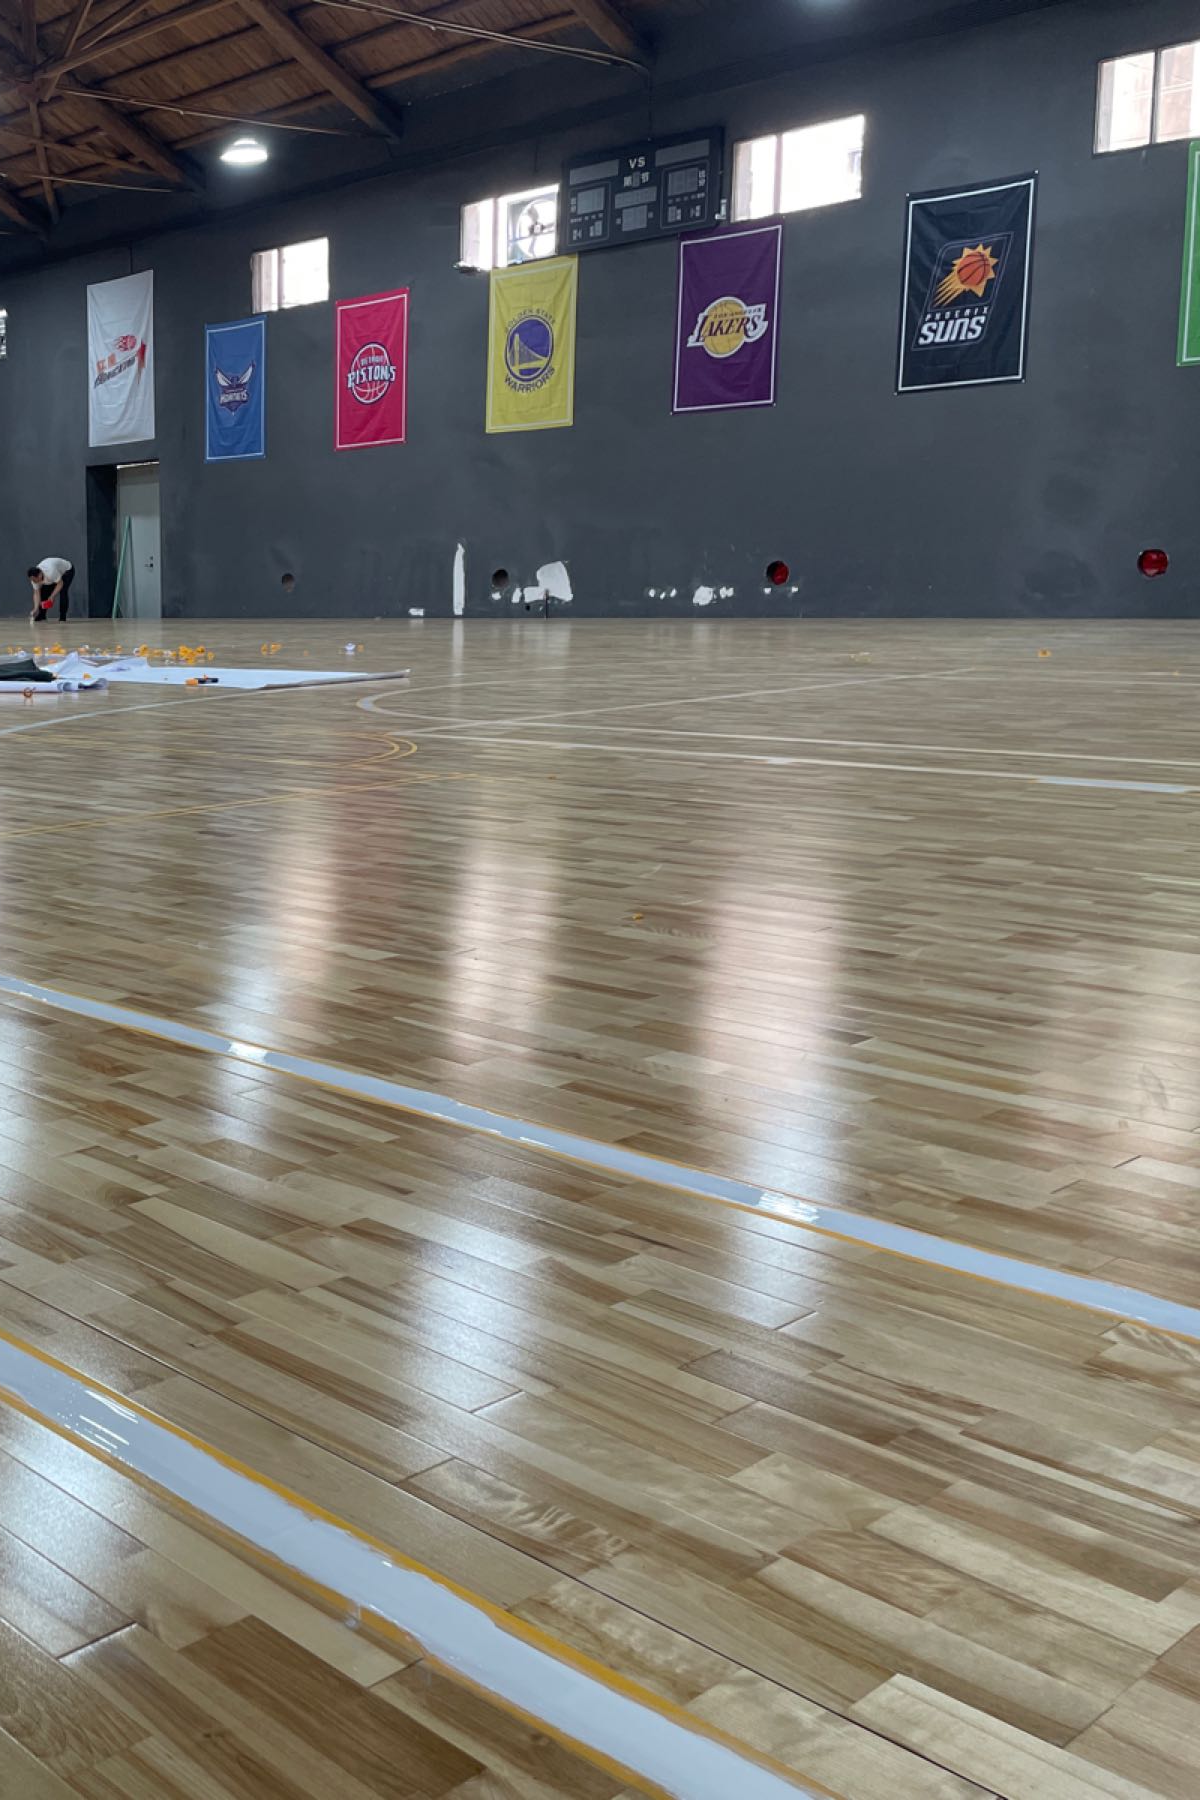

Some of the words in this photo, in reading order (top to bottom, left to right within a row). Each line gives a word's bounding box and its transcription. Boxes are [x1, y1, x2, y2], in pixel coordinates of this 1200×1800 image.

[628, 156, 646, 169] VS
[694, 313, 763, 343] LAKERS
[918, 315, 987, 345] SUNS
[347, 365, 397, 388] PISTONS
[504, 366, 556, 393] WARRIORS
